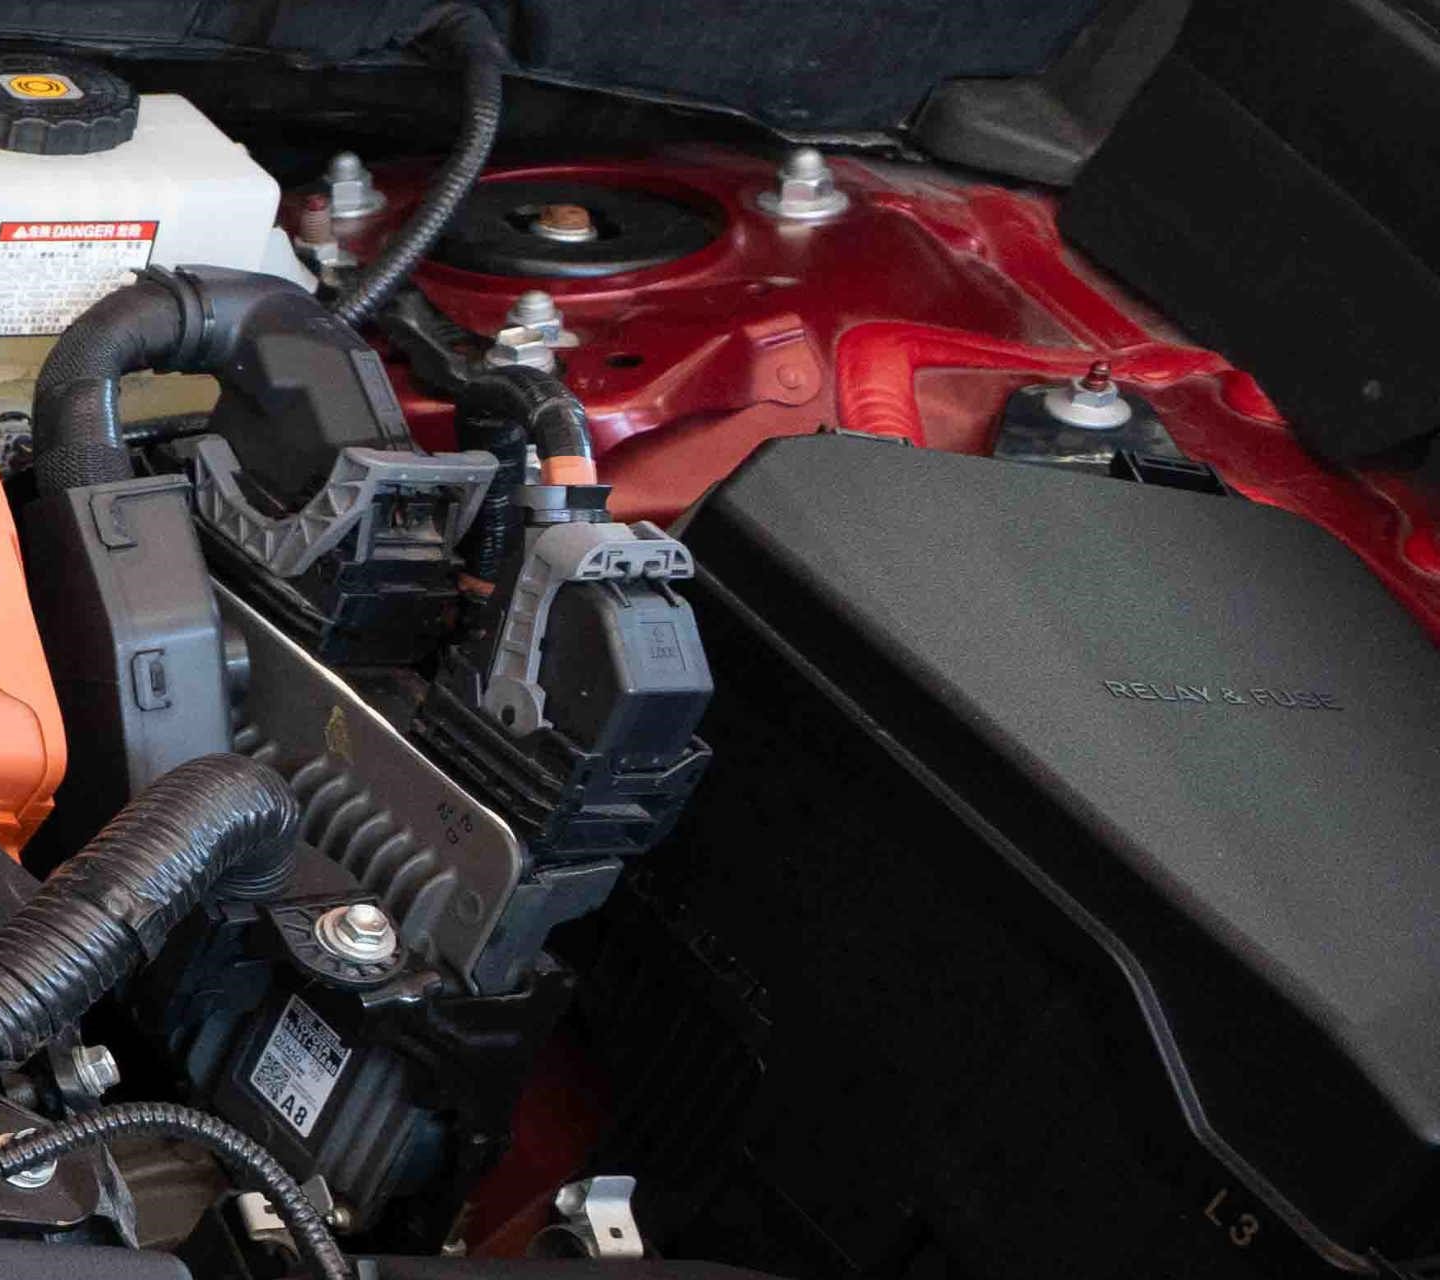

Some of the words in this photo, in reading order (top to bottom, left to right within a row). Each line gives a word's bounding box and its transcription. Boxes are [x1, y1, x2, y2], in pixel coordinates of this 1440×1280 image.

[54, 223, 114, 238] DANGER
[1102, 679, 1209, 704] RELAY
[1222, 687, 1244, 705] &
[1250, 687, 1345, 711] FUSE
[280, 1093, 310, 1127] A8
[1202, 1187, 1260, 1248] L3
